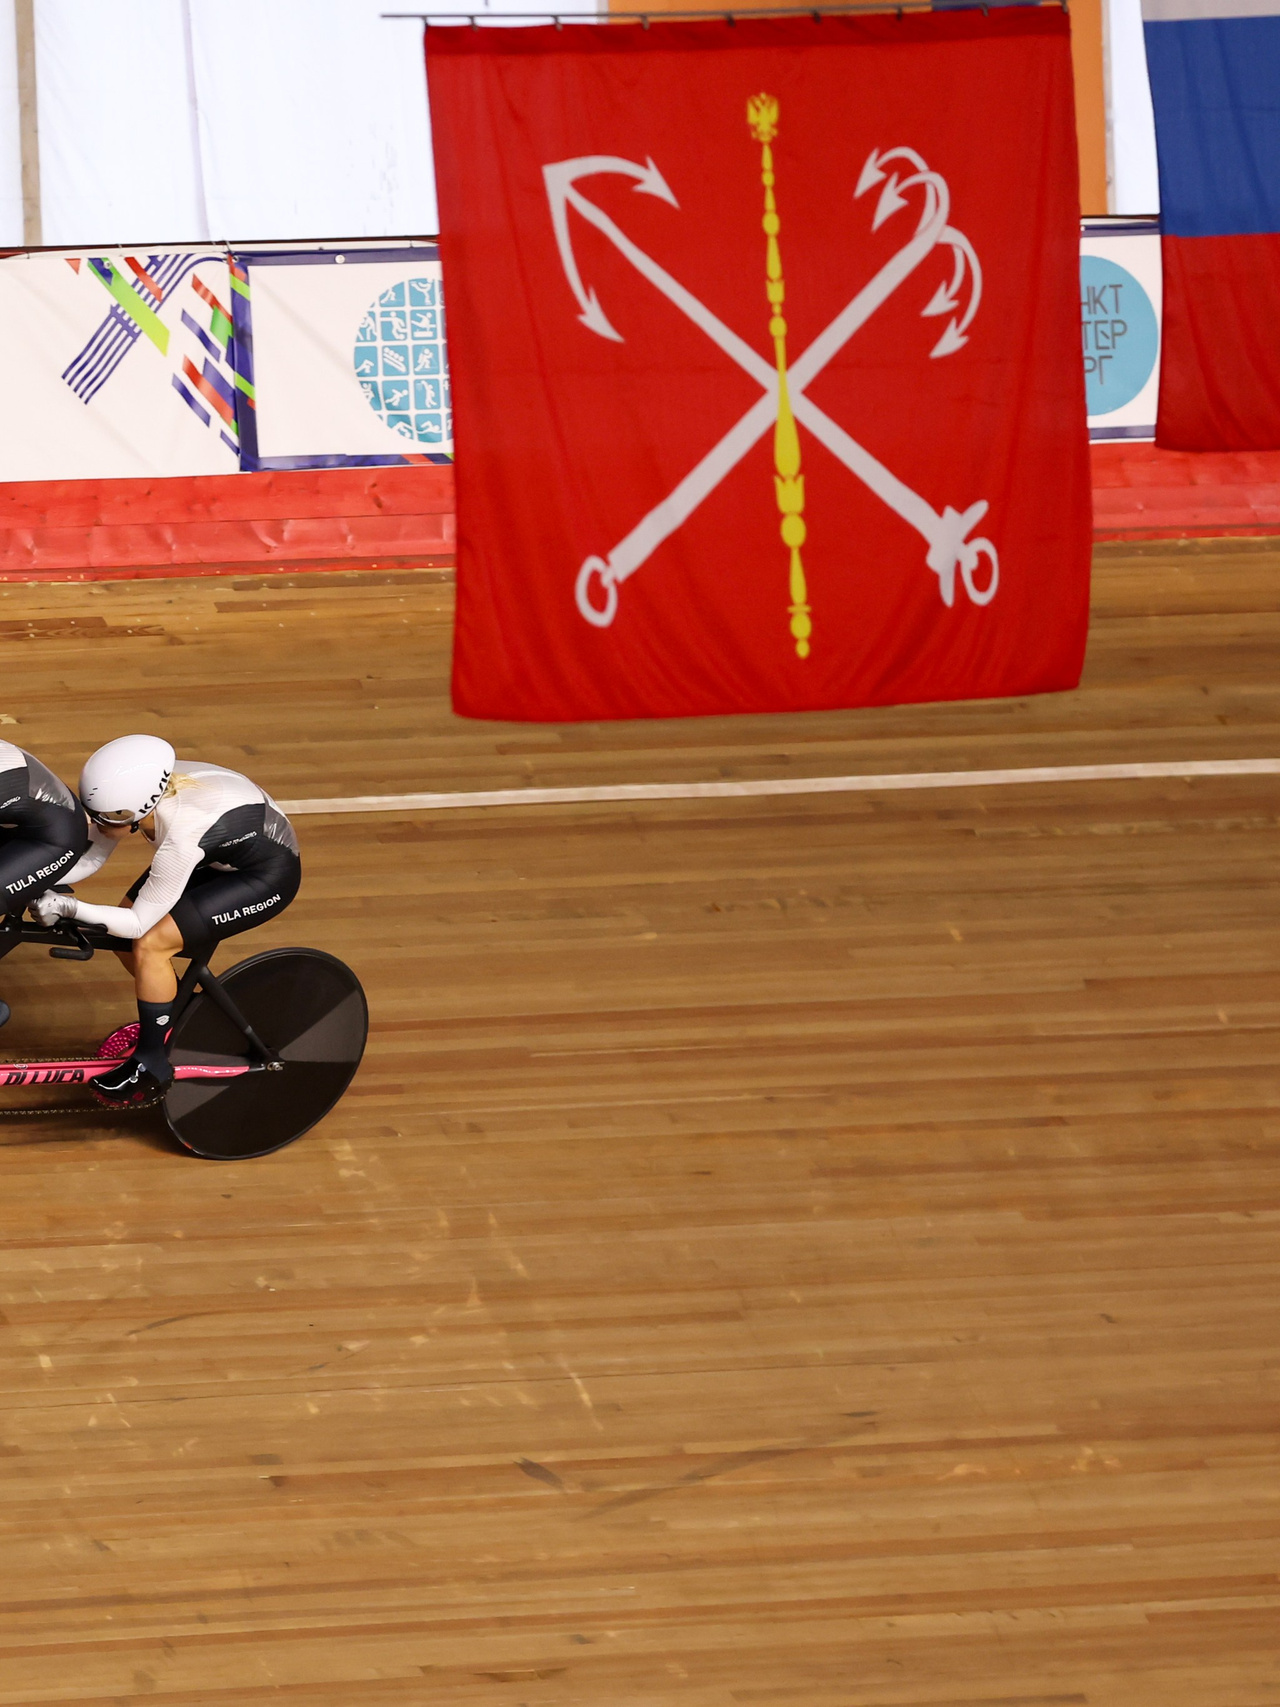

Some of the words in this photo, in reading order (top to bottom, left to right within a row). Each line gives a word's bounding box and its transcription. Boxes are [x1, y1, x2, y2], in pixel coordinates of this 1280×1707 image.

[1081, 284, 1123, 315] НКТ
[1082, 319, 1128, 350] ТЕР
[1083, 355, 1113, 385] РГ
[138, 769, 172, 815] KASK
[5, 874, 37, 895] TULA
[35, 850, 75, 880] REGION
[211, 909, 242, 925] TULA
[242, 893, 282, 917] REGION
[3, 1071, 27, 1086] DI
[28, 1069, 85, 1085] LUCA
